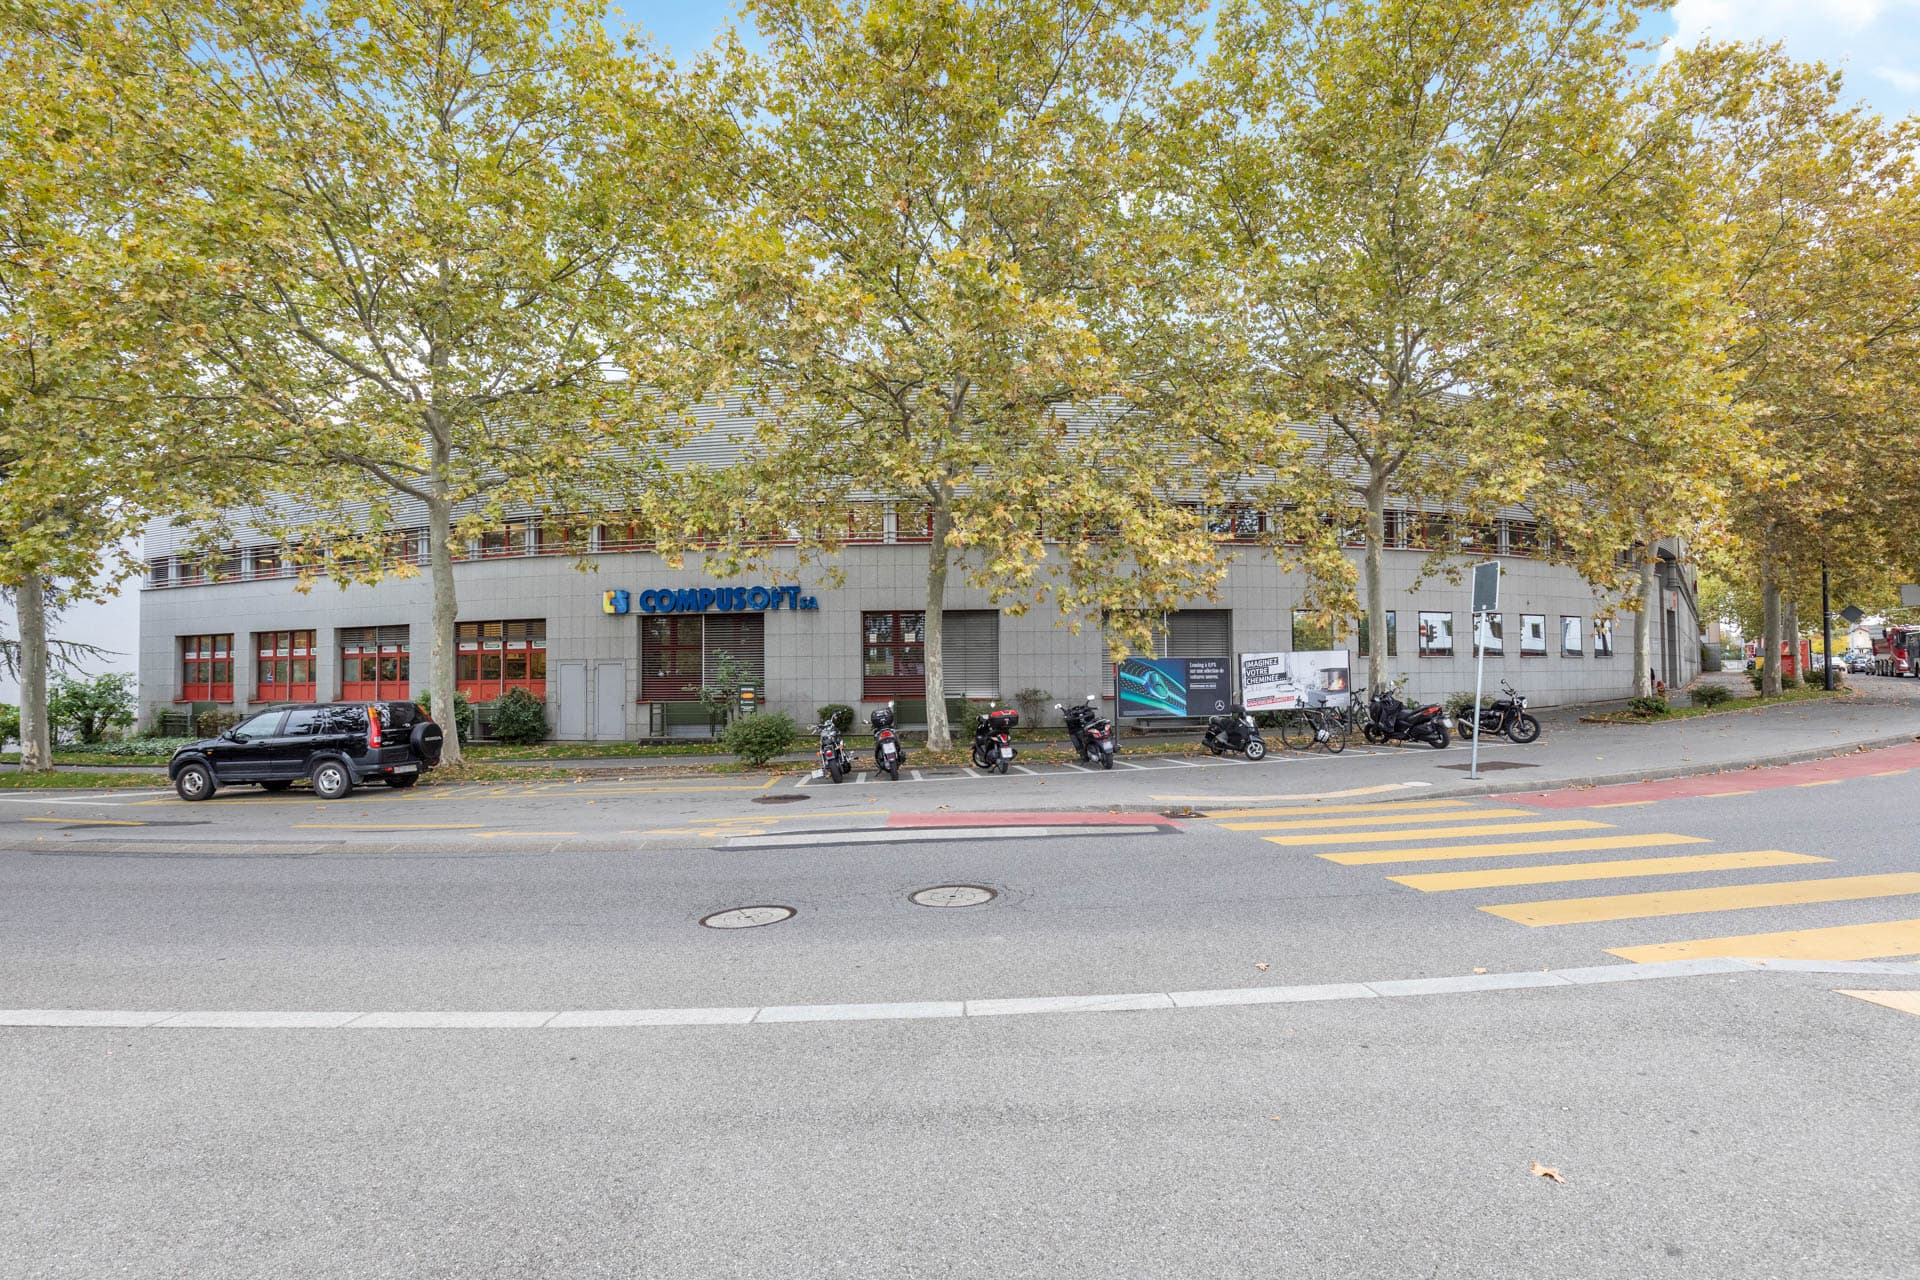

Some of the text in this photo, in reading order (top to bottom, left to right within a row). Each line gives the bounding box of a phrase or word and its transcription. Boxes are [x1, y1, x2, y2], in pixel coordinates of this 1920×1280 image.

[639, 586, 800, 612] COMPUSOFT
[1246, 658, 1277, 667] IMAGINEZ
[1246, 668, 1268, 677] VOTRE
